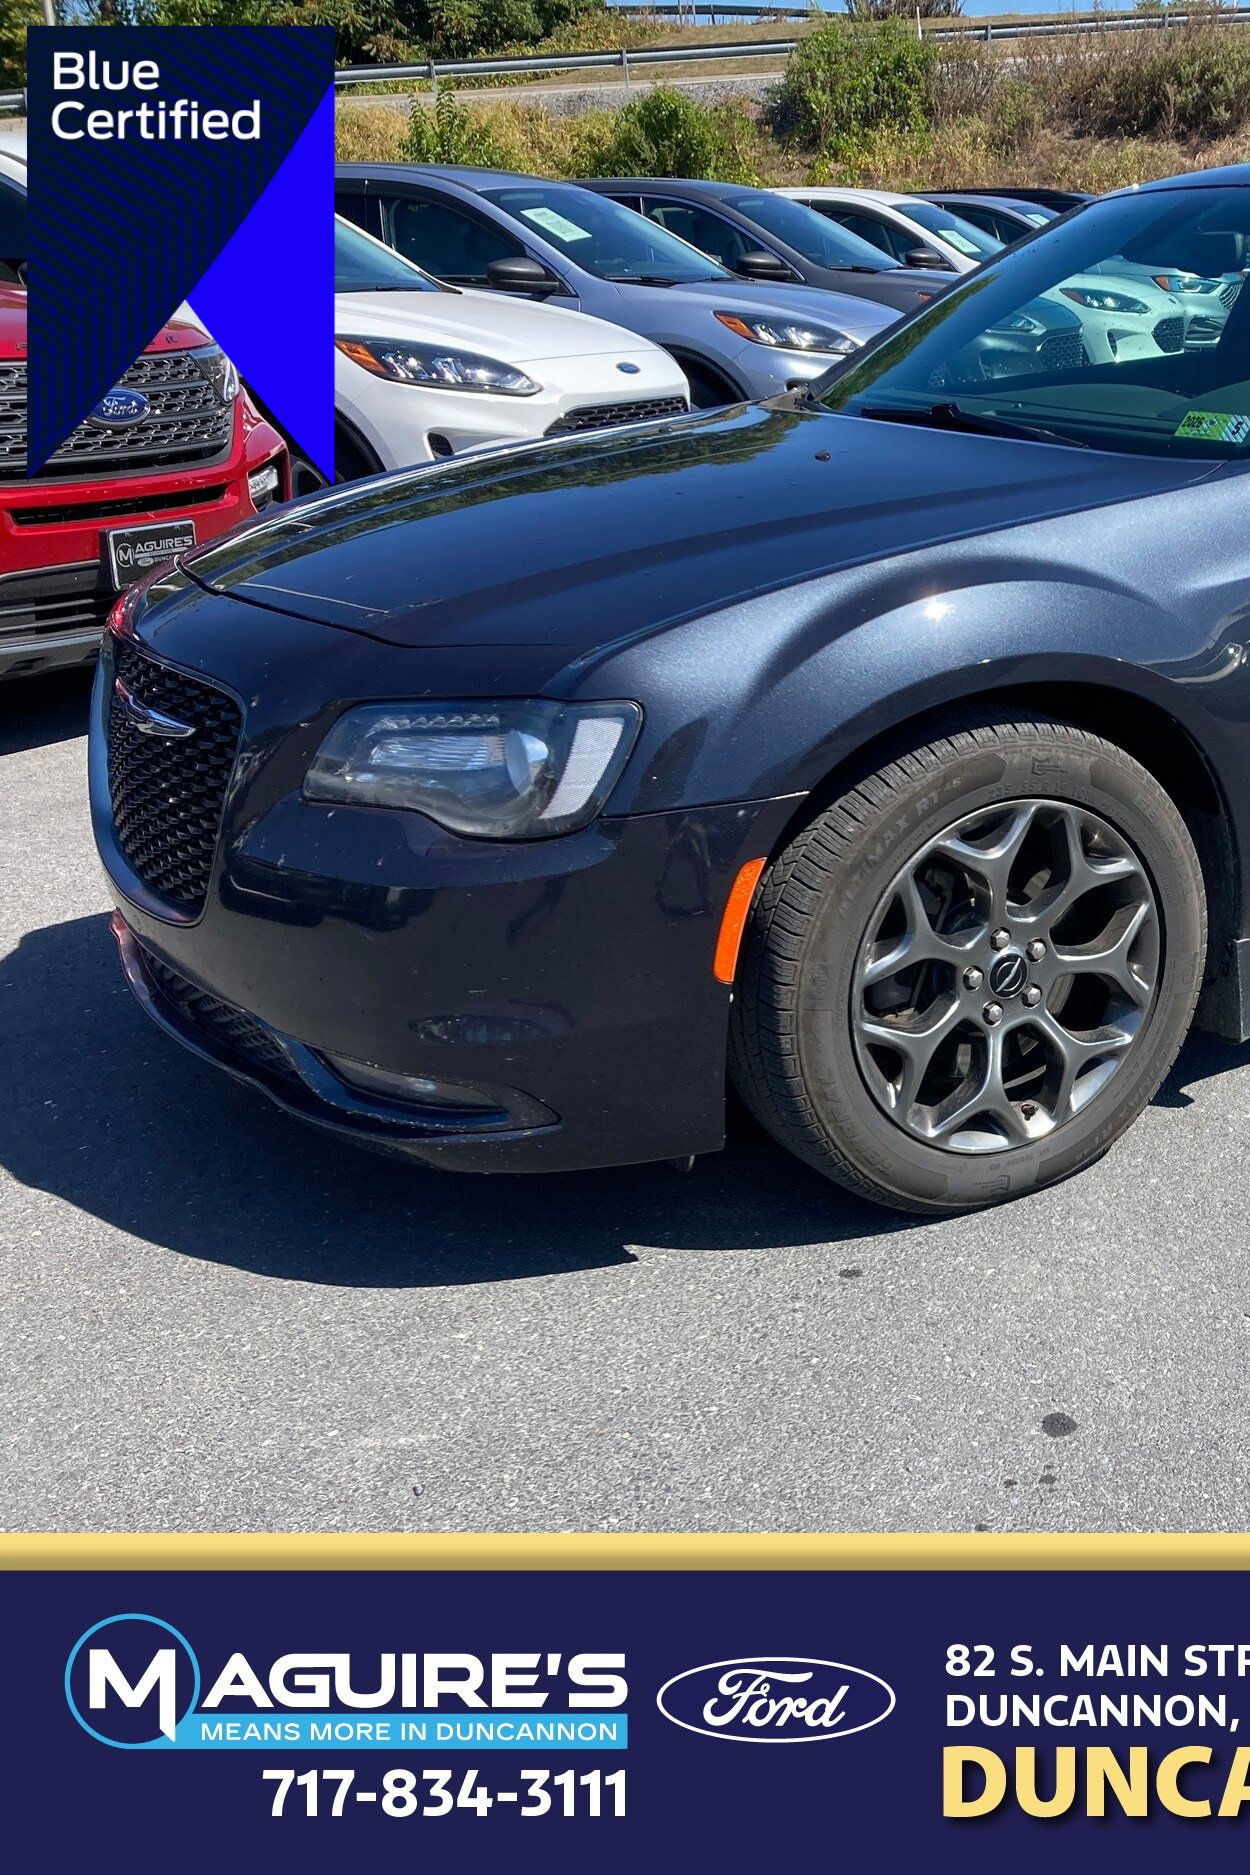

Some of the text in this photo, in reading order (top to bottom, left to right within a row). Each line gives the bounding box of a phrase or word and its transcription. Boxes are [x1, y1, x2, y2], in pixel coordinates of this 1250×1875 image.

[103, 396, 139, 417] Ford
[1231, 421, 1244, 436] 5
[914, 791, 940, 817] RT
